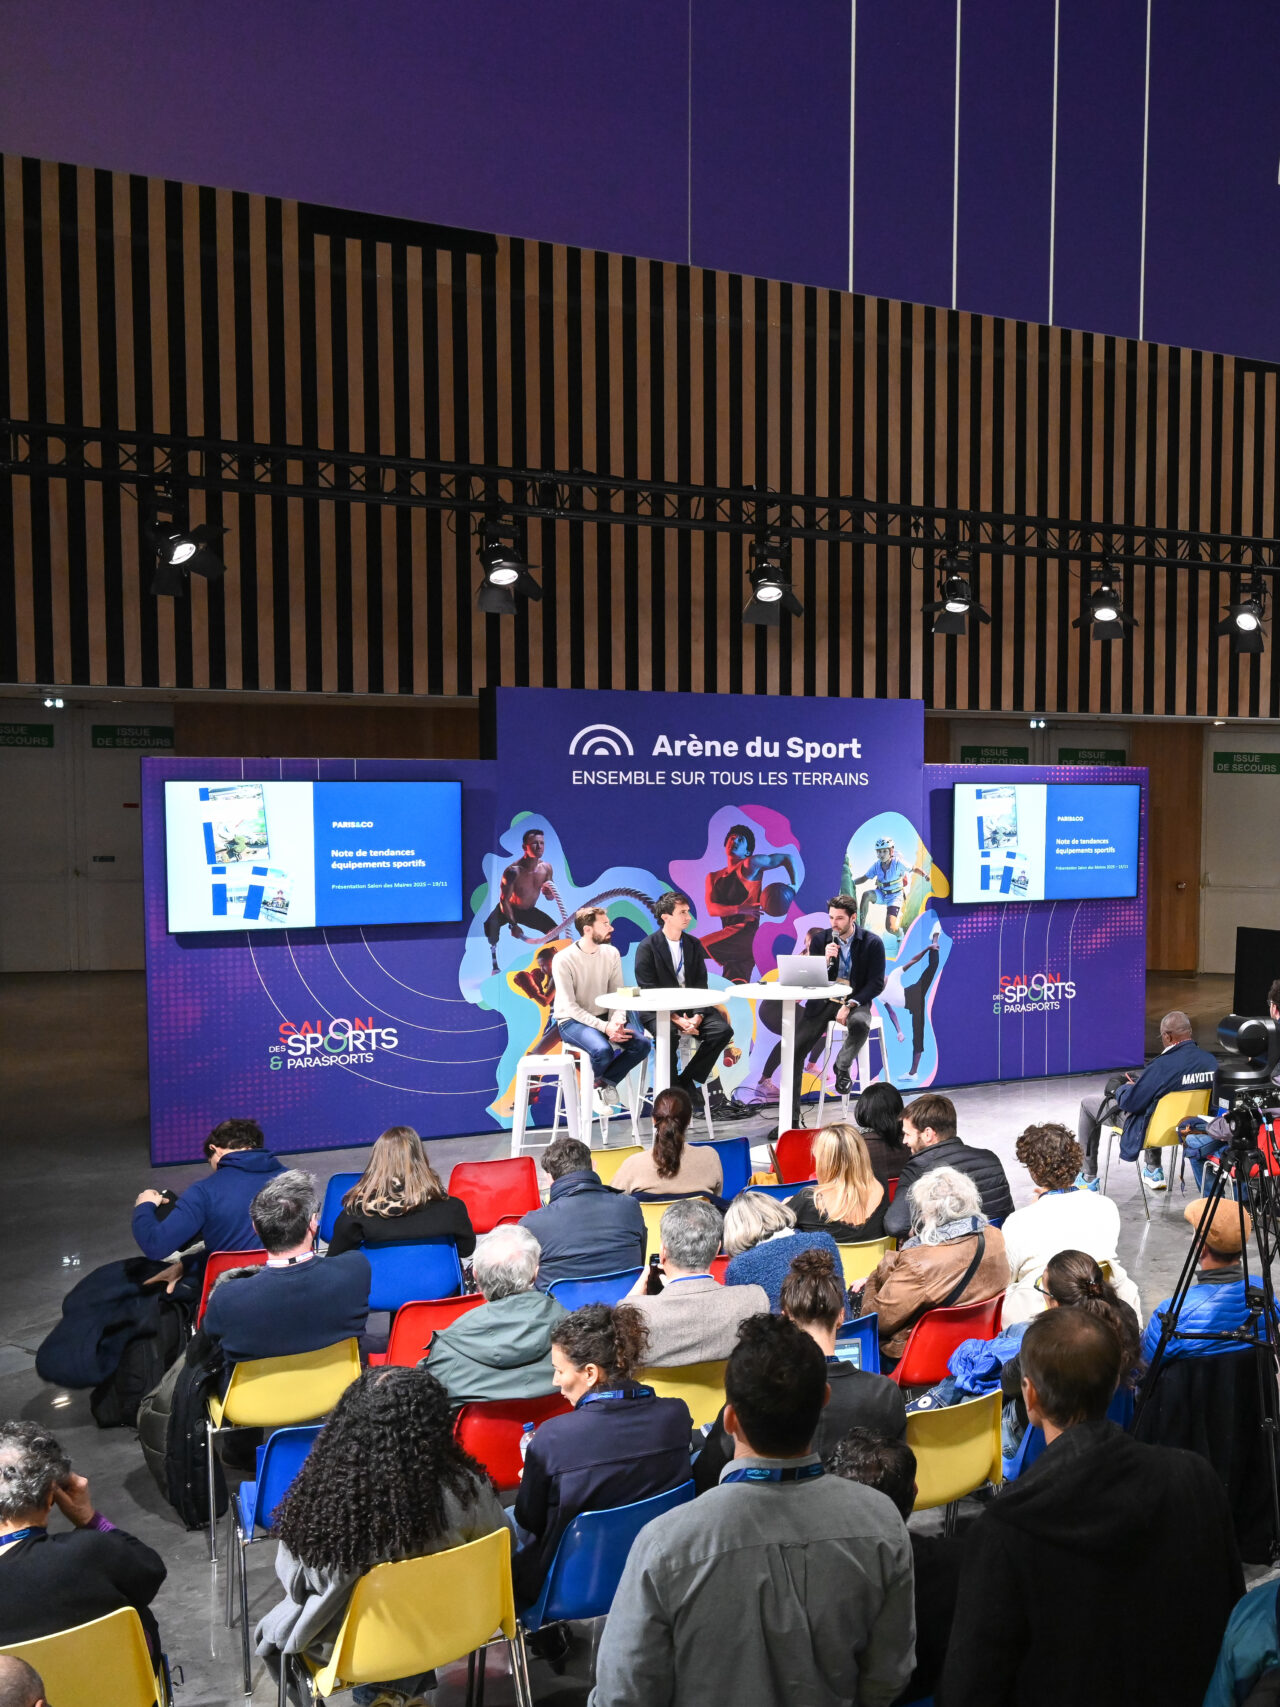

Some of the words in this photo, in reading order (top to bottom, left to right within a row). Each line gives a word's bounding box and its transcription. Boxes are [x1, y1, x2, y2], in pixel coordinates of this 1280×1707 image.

[117, 727, 150, 737] ISSUE
[0, 736, 49, 746] ECOURS
[97, 738, 113, 746] DE
[115, 738, 171, 747] SECOURS
[652, 734, 739, 758] Arène
[746, 736, 780, 758] du
[787, 737, 862, 763] Sport
[981, 748, 1009, 757] ISSUE
[1078, 751, 1106, 759] ISSUE
[1233, 754, 1260, 762] ISSUE
[1217, 763, 1229, 771] DE
[1231, 764, 1277, 773] SECOURS
[572, 771, 666, 785] ENSEMBLE
[671, 771, 705, 785] SUR
[710, 771, 754, 786] TOUS
[758, 772, 788, 786] LES
[793, 772, 869, 786] TERRAINS
[331, 849, 354, 857] Note
[356, 849, 367, 857] de
[370, 848, 415, 857] tendances
[331, 860, 390, 870] équipements
[392, 859, 426, 869] sportifs
[1004, 982, 1076, 1003] SPORTS
[1004, 1001, 1060, 1013] PARASPORTS
[269, 1045, 286, 1053] DES
[287, 1028, 399, 1056] SPORTS
[287, 1053, 374, 1069] PARASPORTS
[1182, 1071, 1215, 1085] MAYOTT
